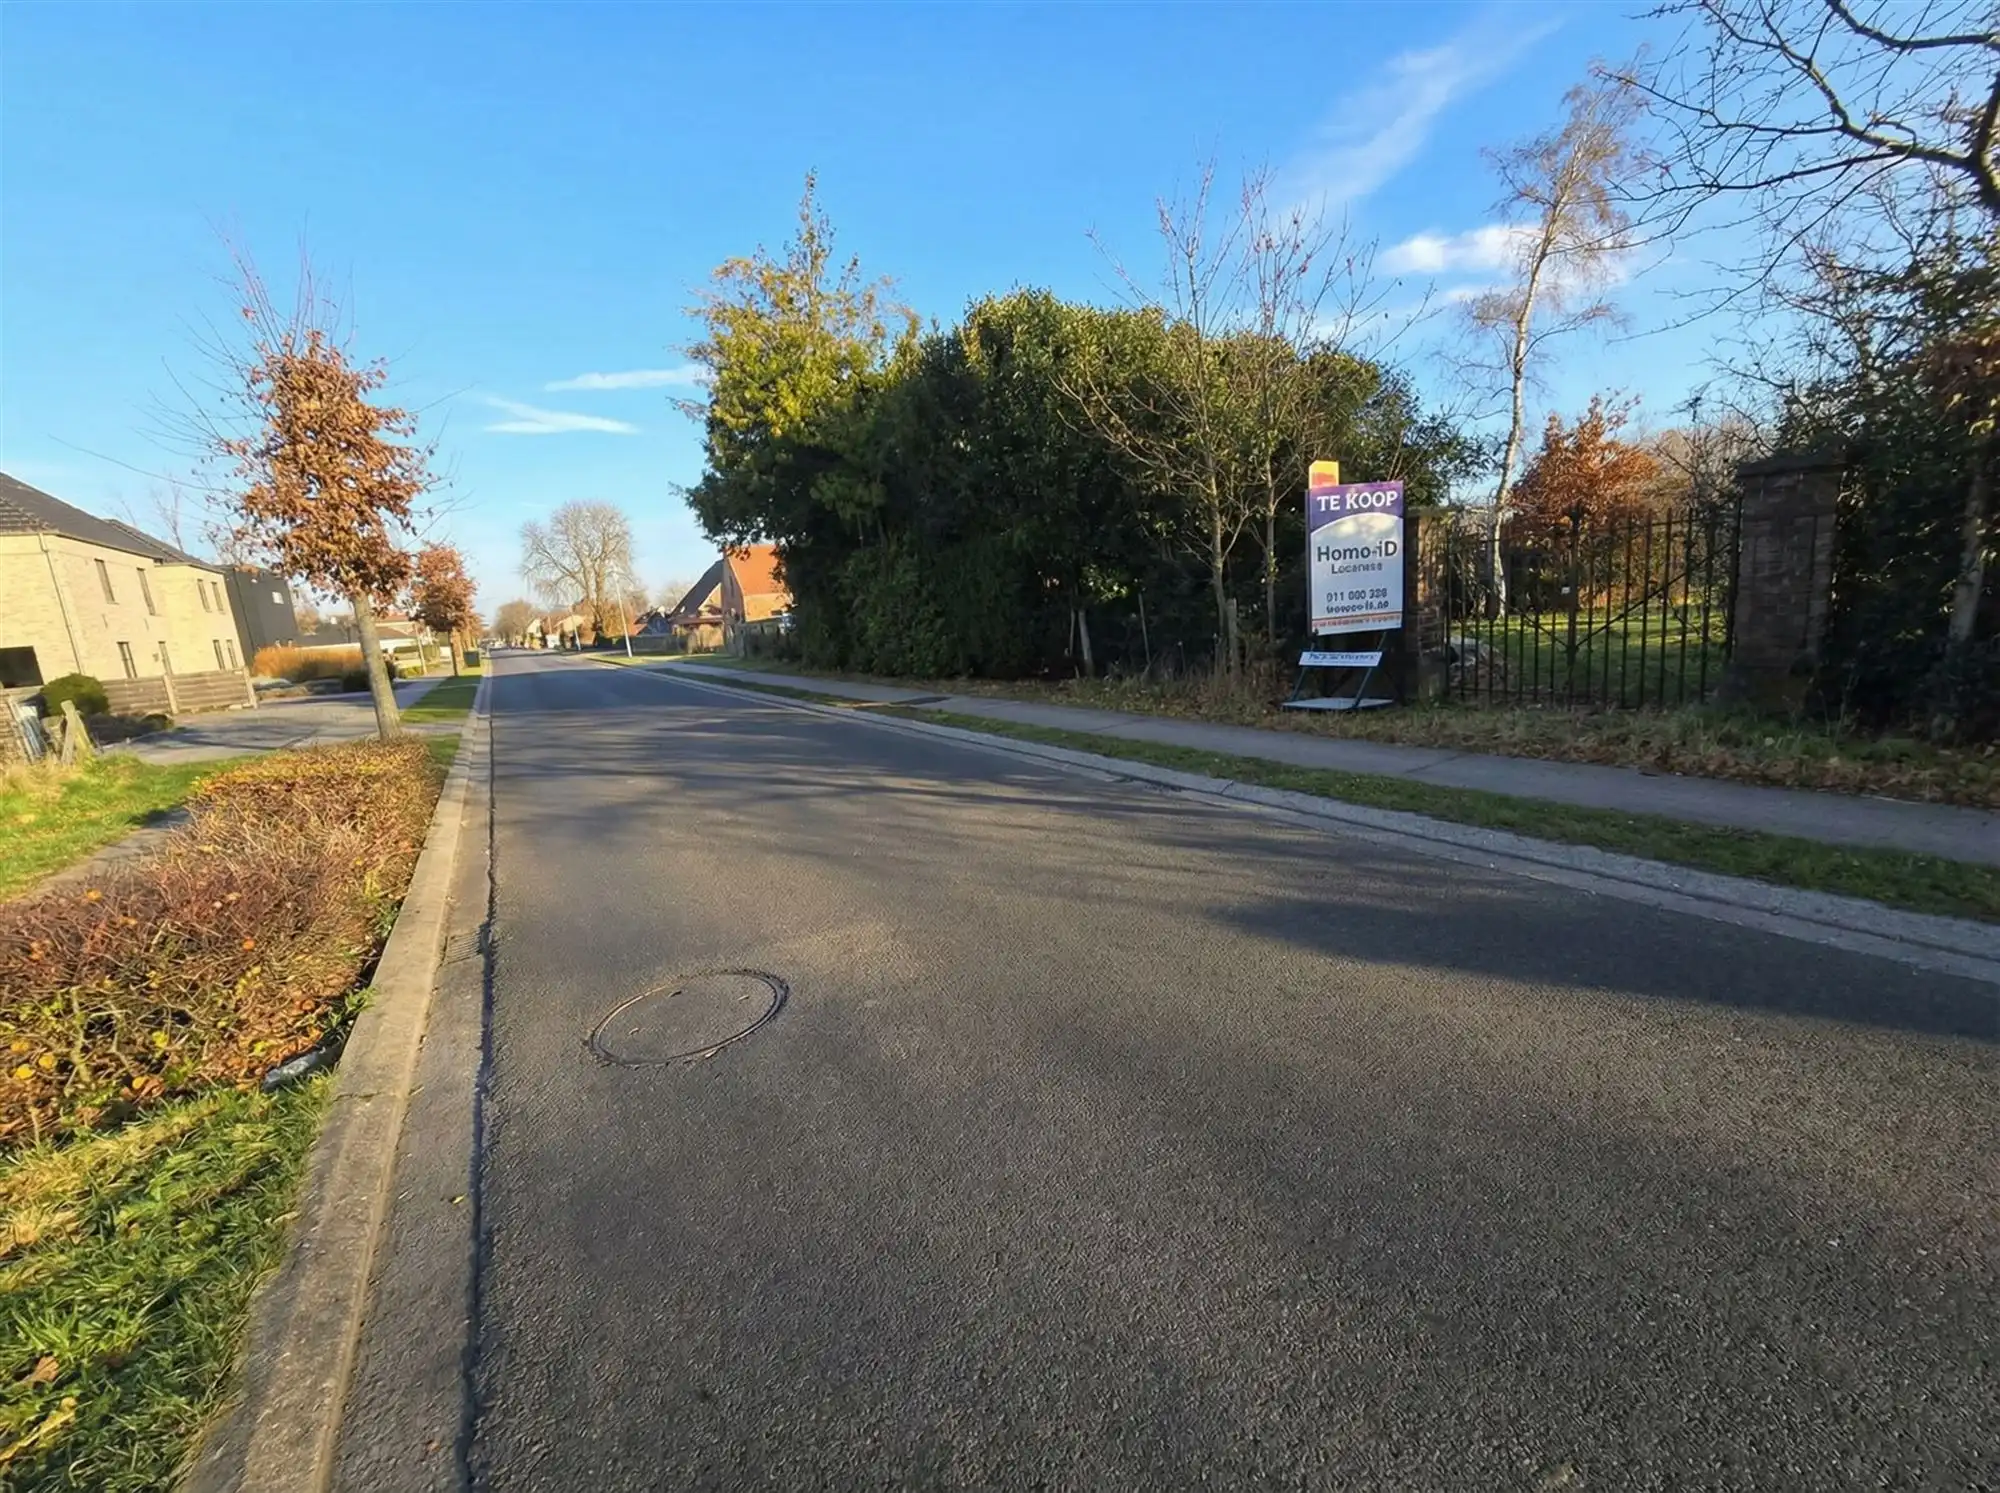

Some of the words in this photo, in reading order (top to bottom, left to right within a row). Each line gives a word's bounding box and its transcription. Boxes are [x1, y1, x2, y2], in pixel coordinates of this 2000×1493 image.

[1317, 495, 1341, 512] TE
[1345, 491, 1398, 510] KOOP
[1326, 592, 1344, 603] 011
